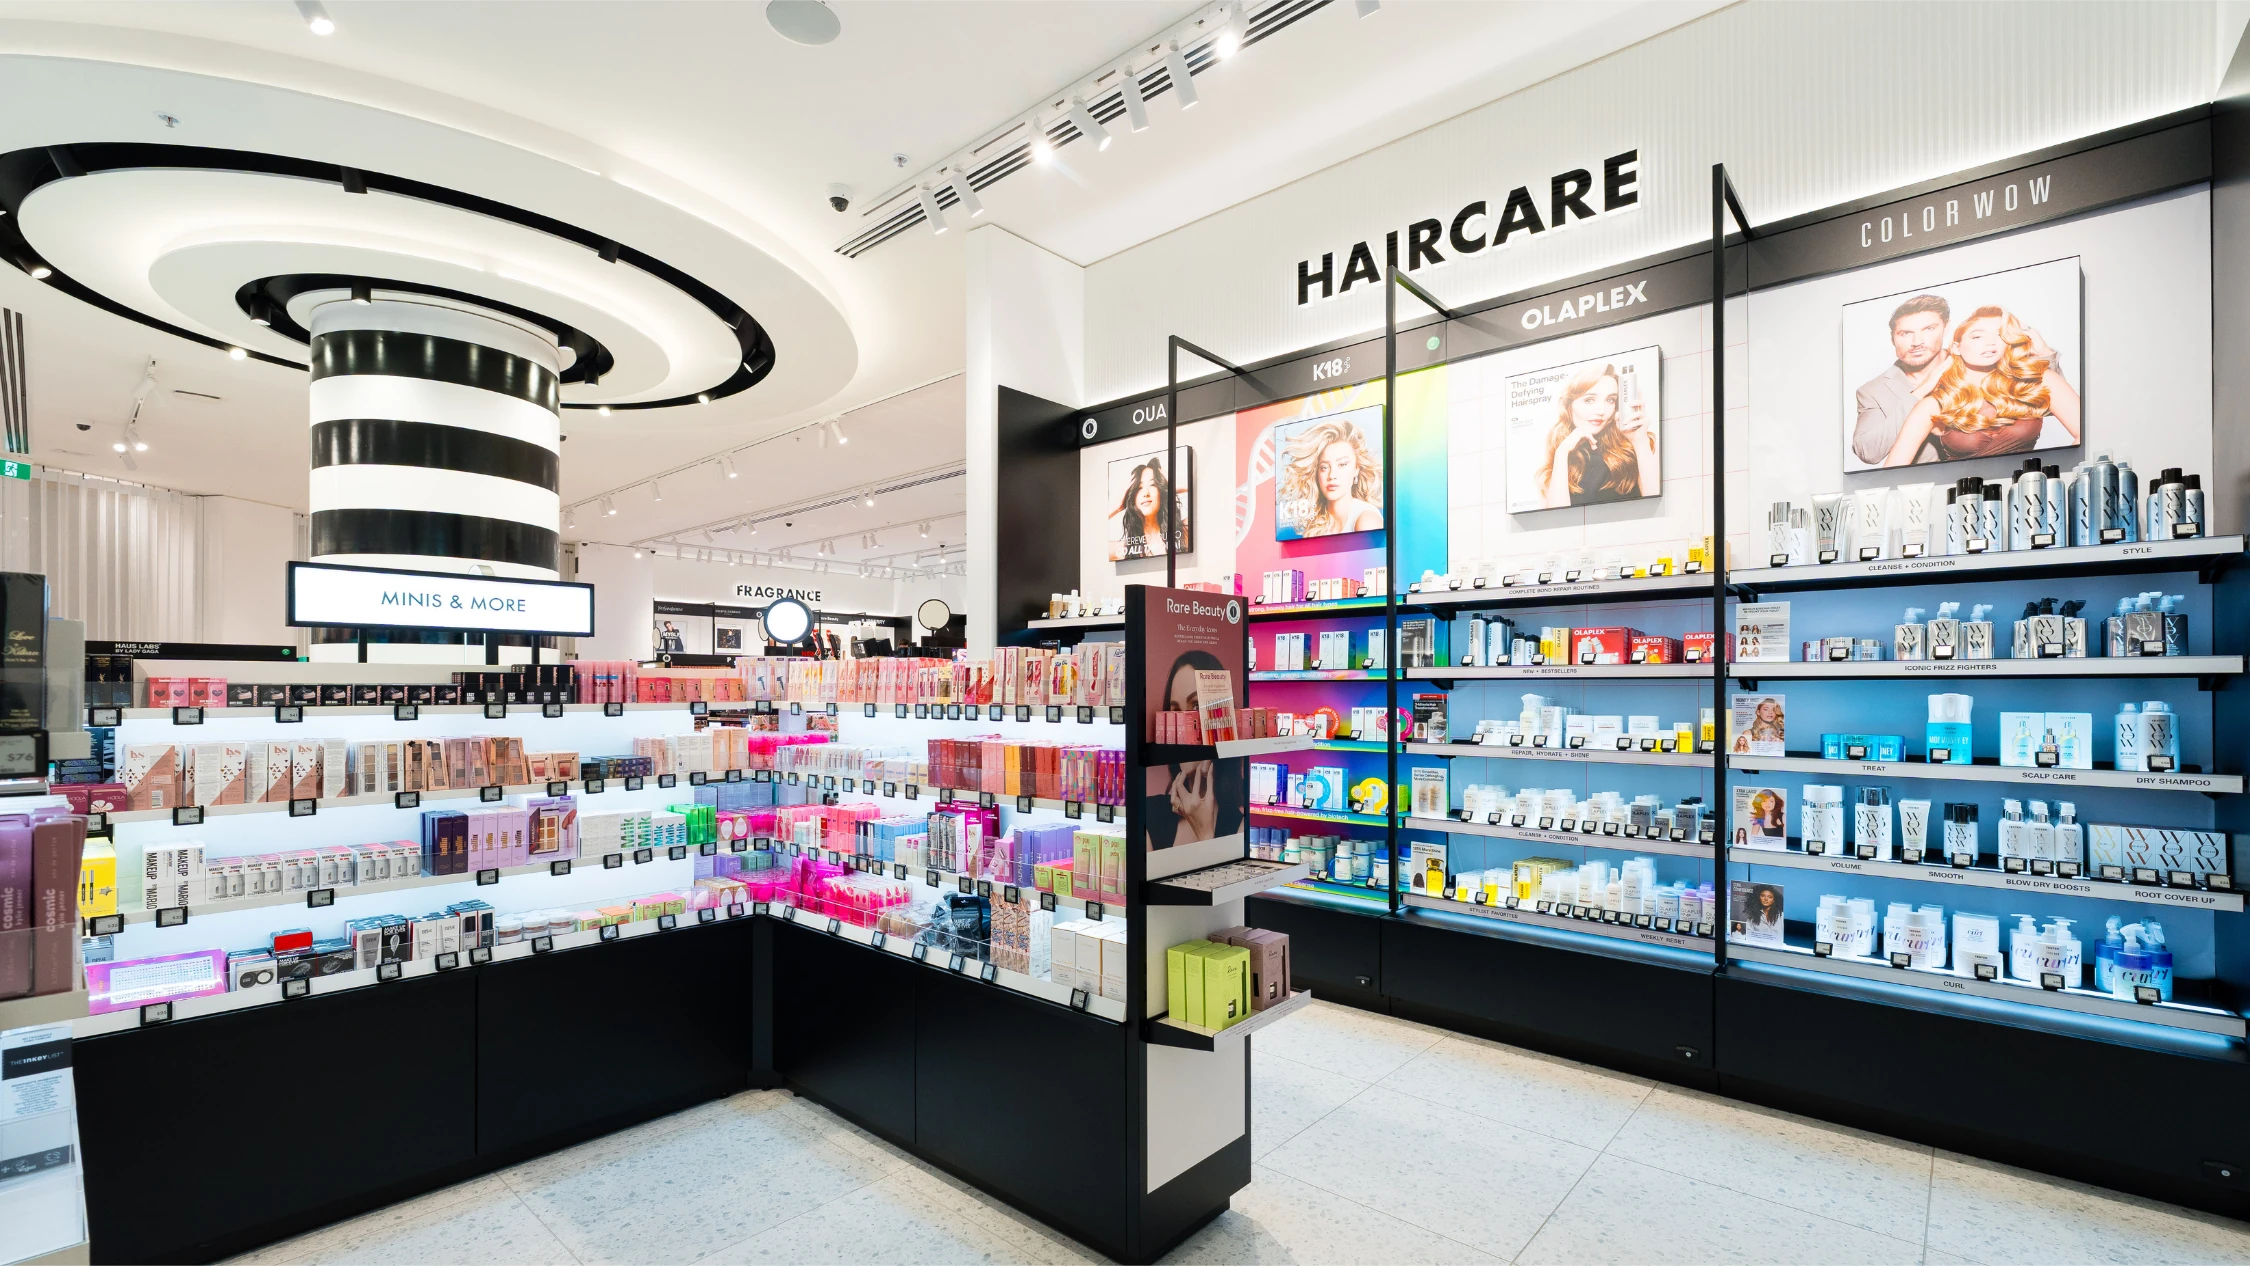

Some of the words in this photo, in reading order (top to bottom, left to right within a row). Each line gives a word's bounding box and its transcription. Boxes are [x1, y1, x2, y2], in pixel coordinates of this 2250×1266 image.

[1861, 200, 1959, 248] COLOR
[1973, 174, 2052, 219] WOW
[1298, 148, 1638, 305] HAIRCARE
[1520, 280, 1648, 330] OLAPLEX
[1313, 358, 1343, 381] K18
[1511, 380, 1527, 389] The
[1511, 386, 1545, 399] Defying
[1511, 394, 1552, 408] Hairspray
[1132, 403, 1168, 425] OUA
[2122, 546, 2153, 555] STYLE
[1911, 560, 1956, 569] CONDITION
[381, 590, 442, 608] MINIS
[450, 594, 464, 610] &
[471, 597, 526, 612] MORE
[737, 584, 821, 602] FRAGRANCE
[1166, 598, 1190, 615] Rare
[1193, 601, 1226, 622] Beauty
[7, 752, 34, 761] $76
[2022, 772, 2050, 780] SCALP
[2052, 773, 2076, 781] CARE
[2158, 778, 2211, 787] SHAMPOO
[620, 816, 635, 849] Milk
[637, 815, 651, 848] Milk
[653, 825, 663, 847] Milk
[665, 823, 675, 845] Milk
[675, 822, 686, 844] Milk
[1548, 834, 1579, 842] CONDITION
[146, 852, 158, 880] MAKEUP
[178, 849, 188, 877] MAKEUP
[1830, 862, 1862, 870] VOLUME
[1928, 871, 1964, 880] SMOOTH
[2005, 878, 2032, 887] BLOW
[2033, 881, 2051, 889] DRY
[2053, 883, 2091, 892] BOOSTS
[146, 887, 158, 910] MARIO
[178, 884, 189, 908] MARIO
[2134, 890, 2162, 899] ROOT
[2164, 893, 2199, 903] COVER
[1, 886, 14, 930] cosmic
[42, 888, 56, 933] cosmic
[1640, 933, 1664, 941] WEEKLY
[1666, 936, 1686, 945] RESET
[1943, 980, 1965, 990] CURL
